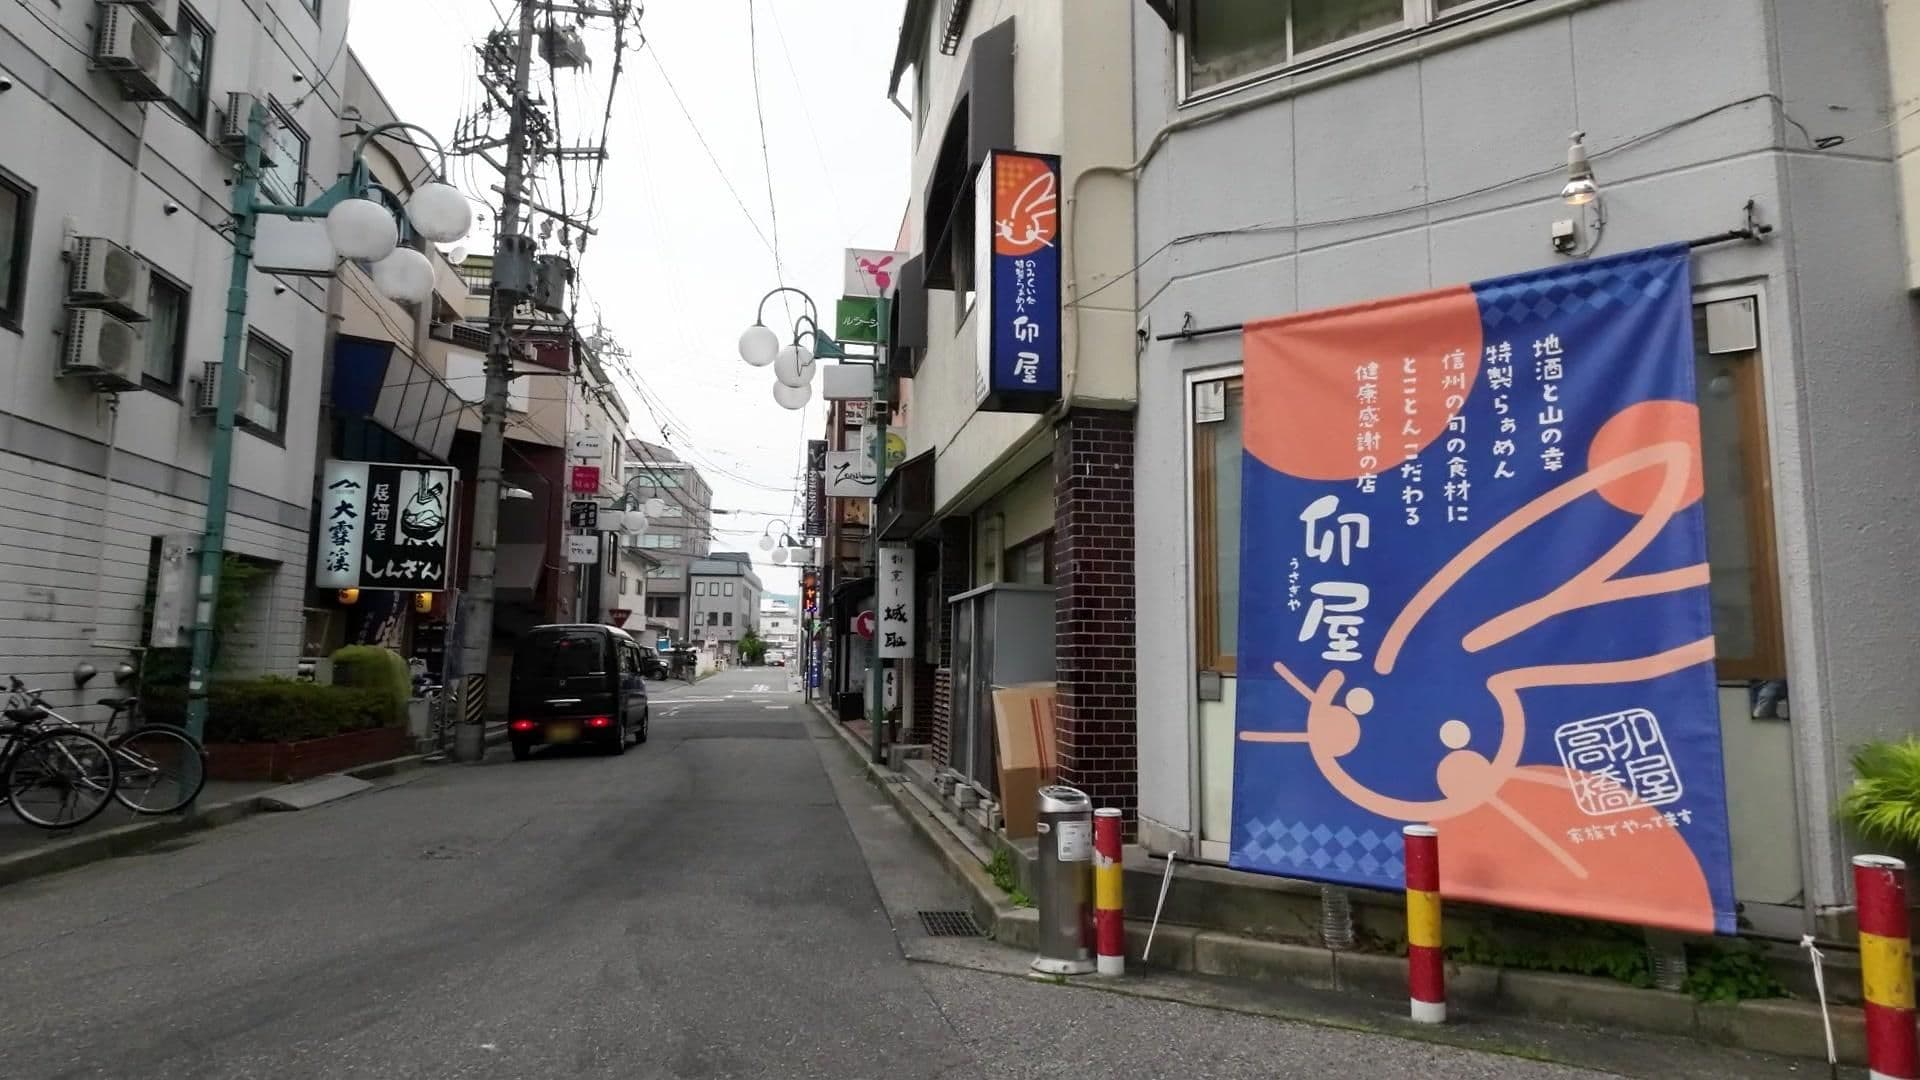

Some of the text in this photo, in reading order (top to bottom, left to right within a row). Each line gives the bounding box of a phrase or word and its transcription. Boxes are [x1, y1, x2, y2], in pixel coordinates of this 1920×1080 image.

[1012, 315, 1040, 384] 卯屋
[1486, 340, 1517, 480] 特製らぁめん
[1532, 332, 1565, 472] 地酒と山の幸
[1354, 360, 1382, 494] 健康感謝の店
[1400, 356, 1425, 526] とことんこだわる
[1441, 348, 1471, 524] 信州の旬の食材に
[365, 550, 443, 581] しんざん
[369, 483, 391, 542] 居酒屋
[1298, 494, 1370, 662] 卯屋
[1287, 557, 1302, 612] うさぎや
[1567, 808, 1693, 845] 家族でやってます
